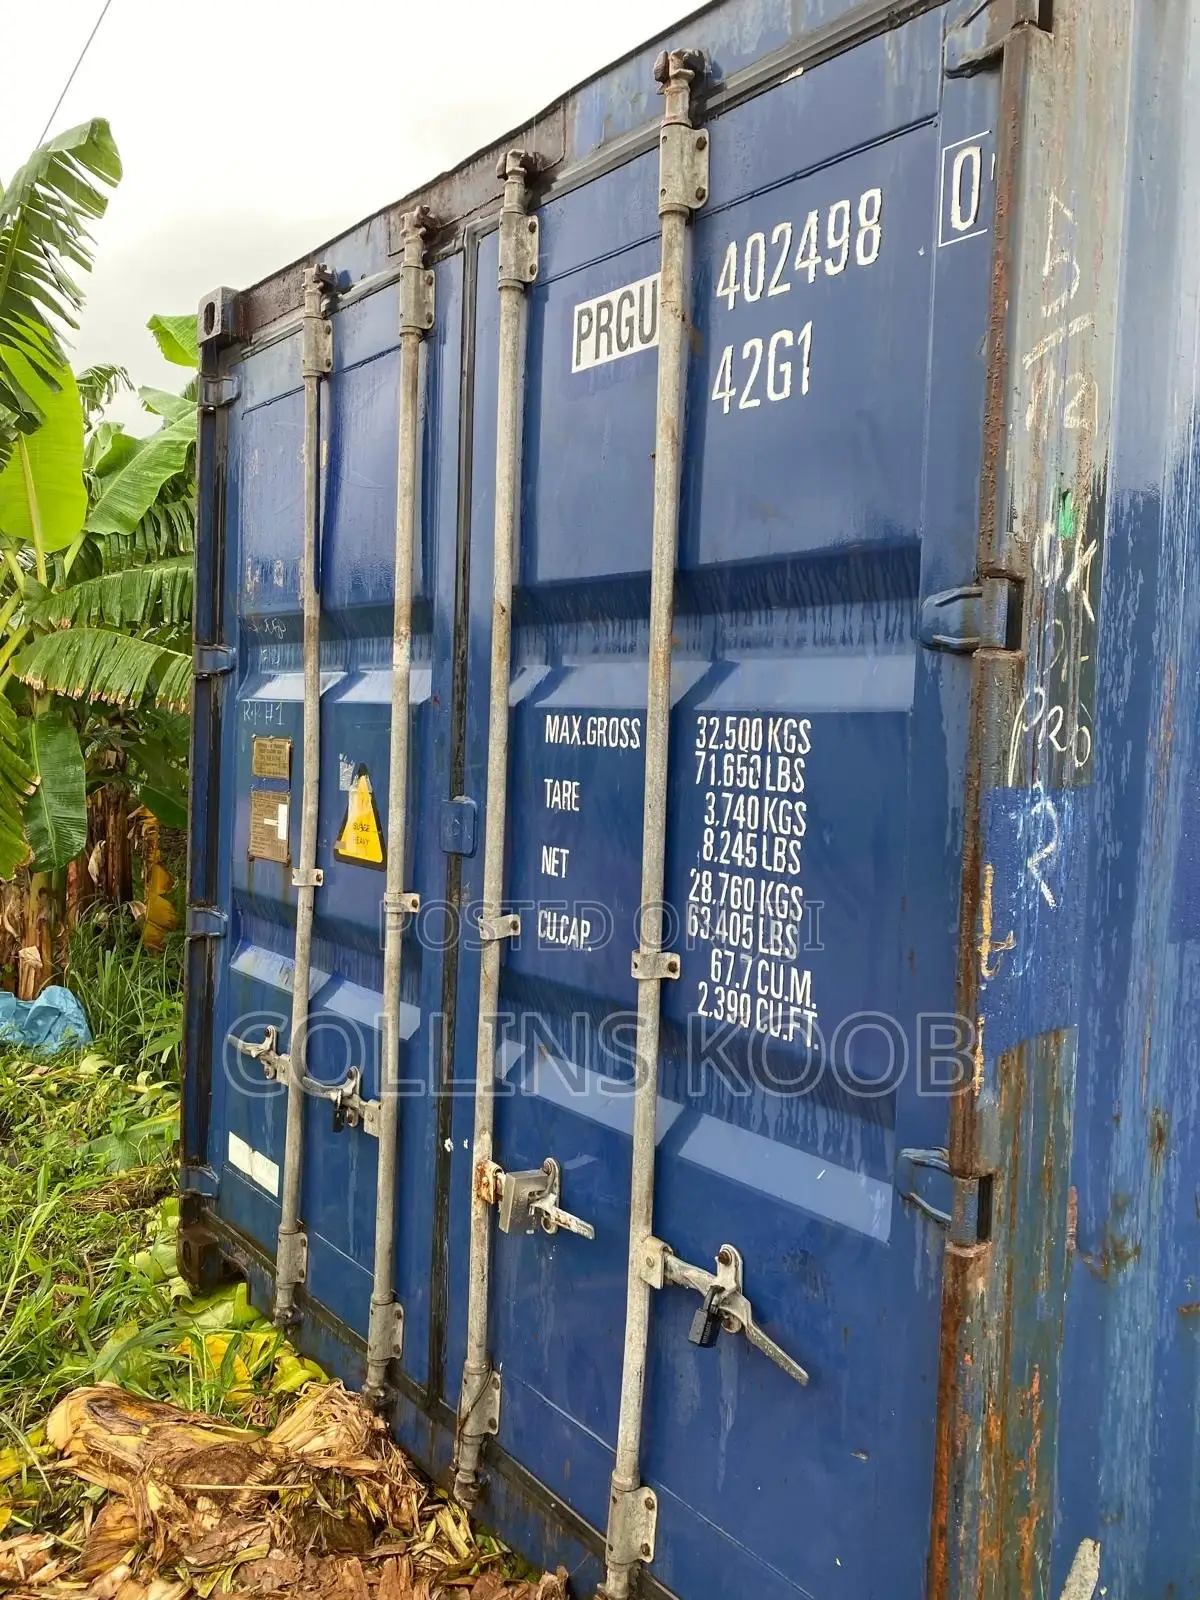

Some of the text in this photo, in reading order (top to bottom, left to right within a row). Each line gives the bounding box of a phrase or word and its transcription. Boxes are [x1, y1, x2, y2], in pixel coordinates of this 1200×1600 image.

[575, 146, 982, 366] PRGU 402498 0
[712, 321, 814, 414] 42G1
[545, 715, 641, 749] MAX.GROSS
[768, 717, 812, 754] KGS
[765, 755, 806, 794] LBS
[544, 778, 580, 811] TARE
[763, 796, 807, 836] KGS
[761, 834, 802, 875] LBS
[541, 845, 569, 878] NET
[760, 879, 804, 921] KGS
[538, 909, 817, 1009] CU.CAP. 67.7 CU.M.
[758, 917, 799, 960] LBS
[756, 997, 819, 1050] CU.FT.
